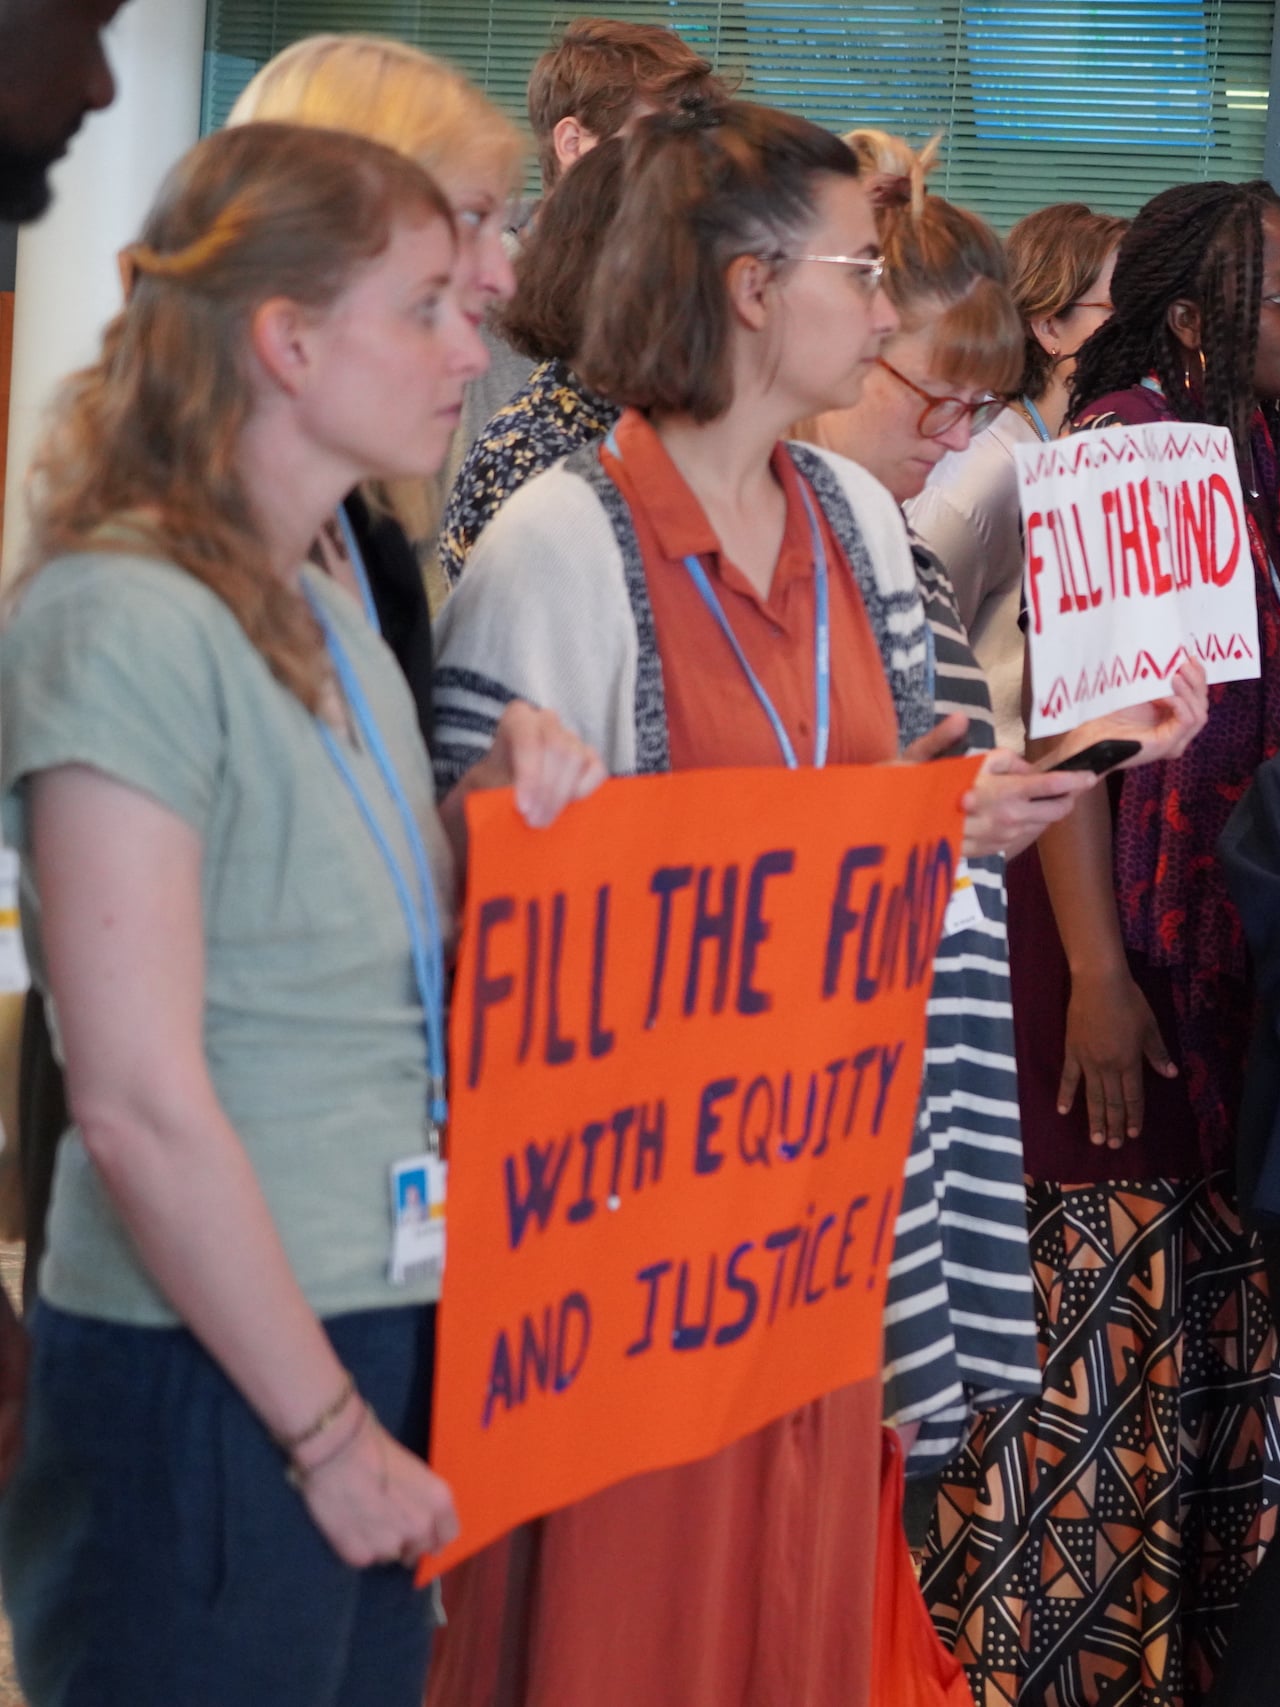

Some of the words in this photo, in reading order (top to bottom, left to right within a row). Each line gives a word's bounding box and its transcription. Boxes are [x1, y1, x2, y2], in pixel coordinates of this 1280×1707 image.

[1028, 503, 1103, 634] FILL
[1102, 476, 1172, 600] THE
[466, 882, 616, 1090] FILL
[643, 848, 797, 1030] THE
[822, 836, 952, 1003] FUND
[505, 1098, 667, 1251] WITH
[694, 1041, 904, 1175] EQUITY
[481, 1290, 592, 1429] AND
